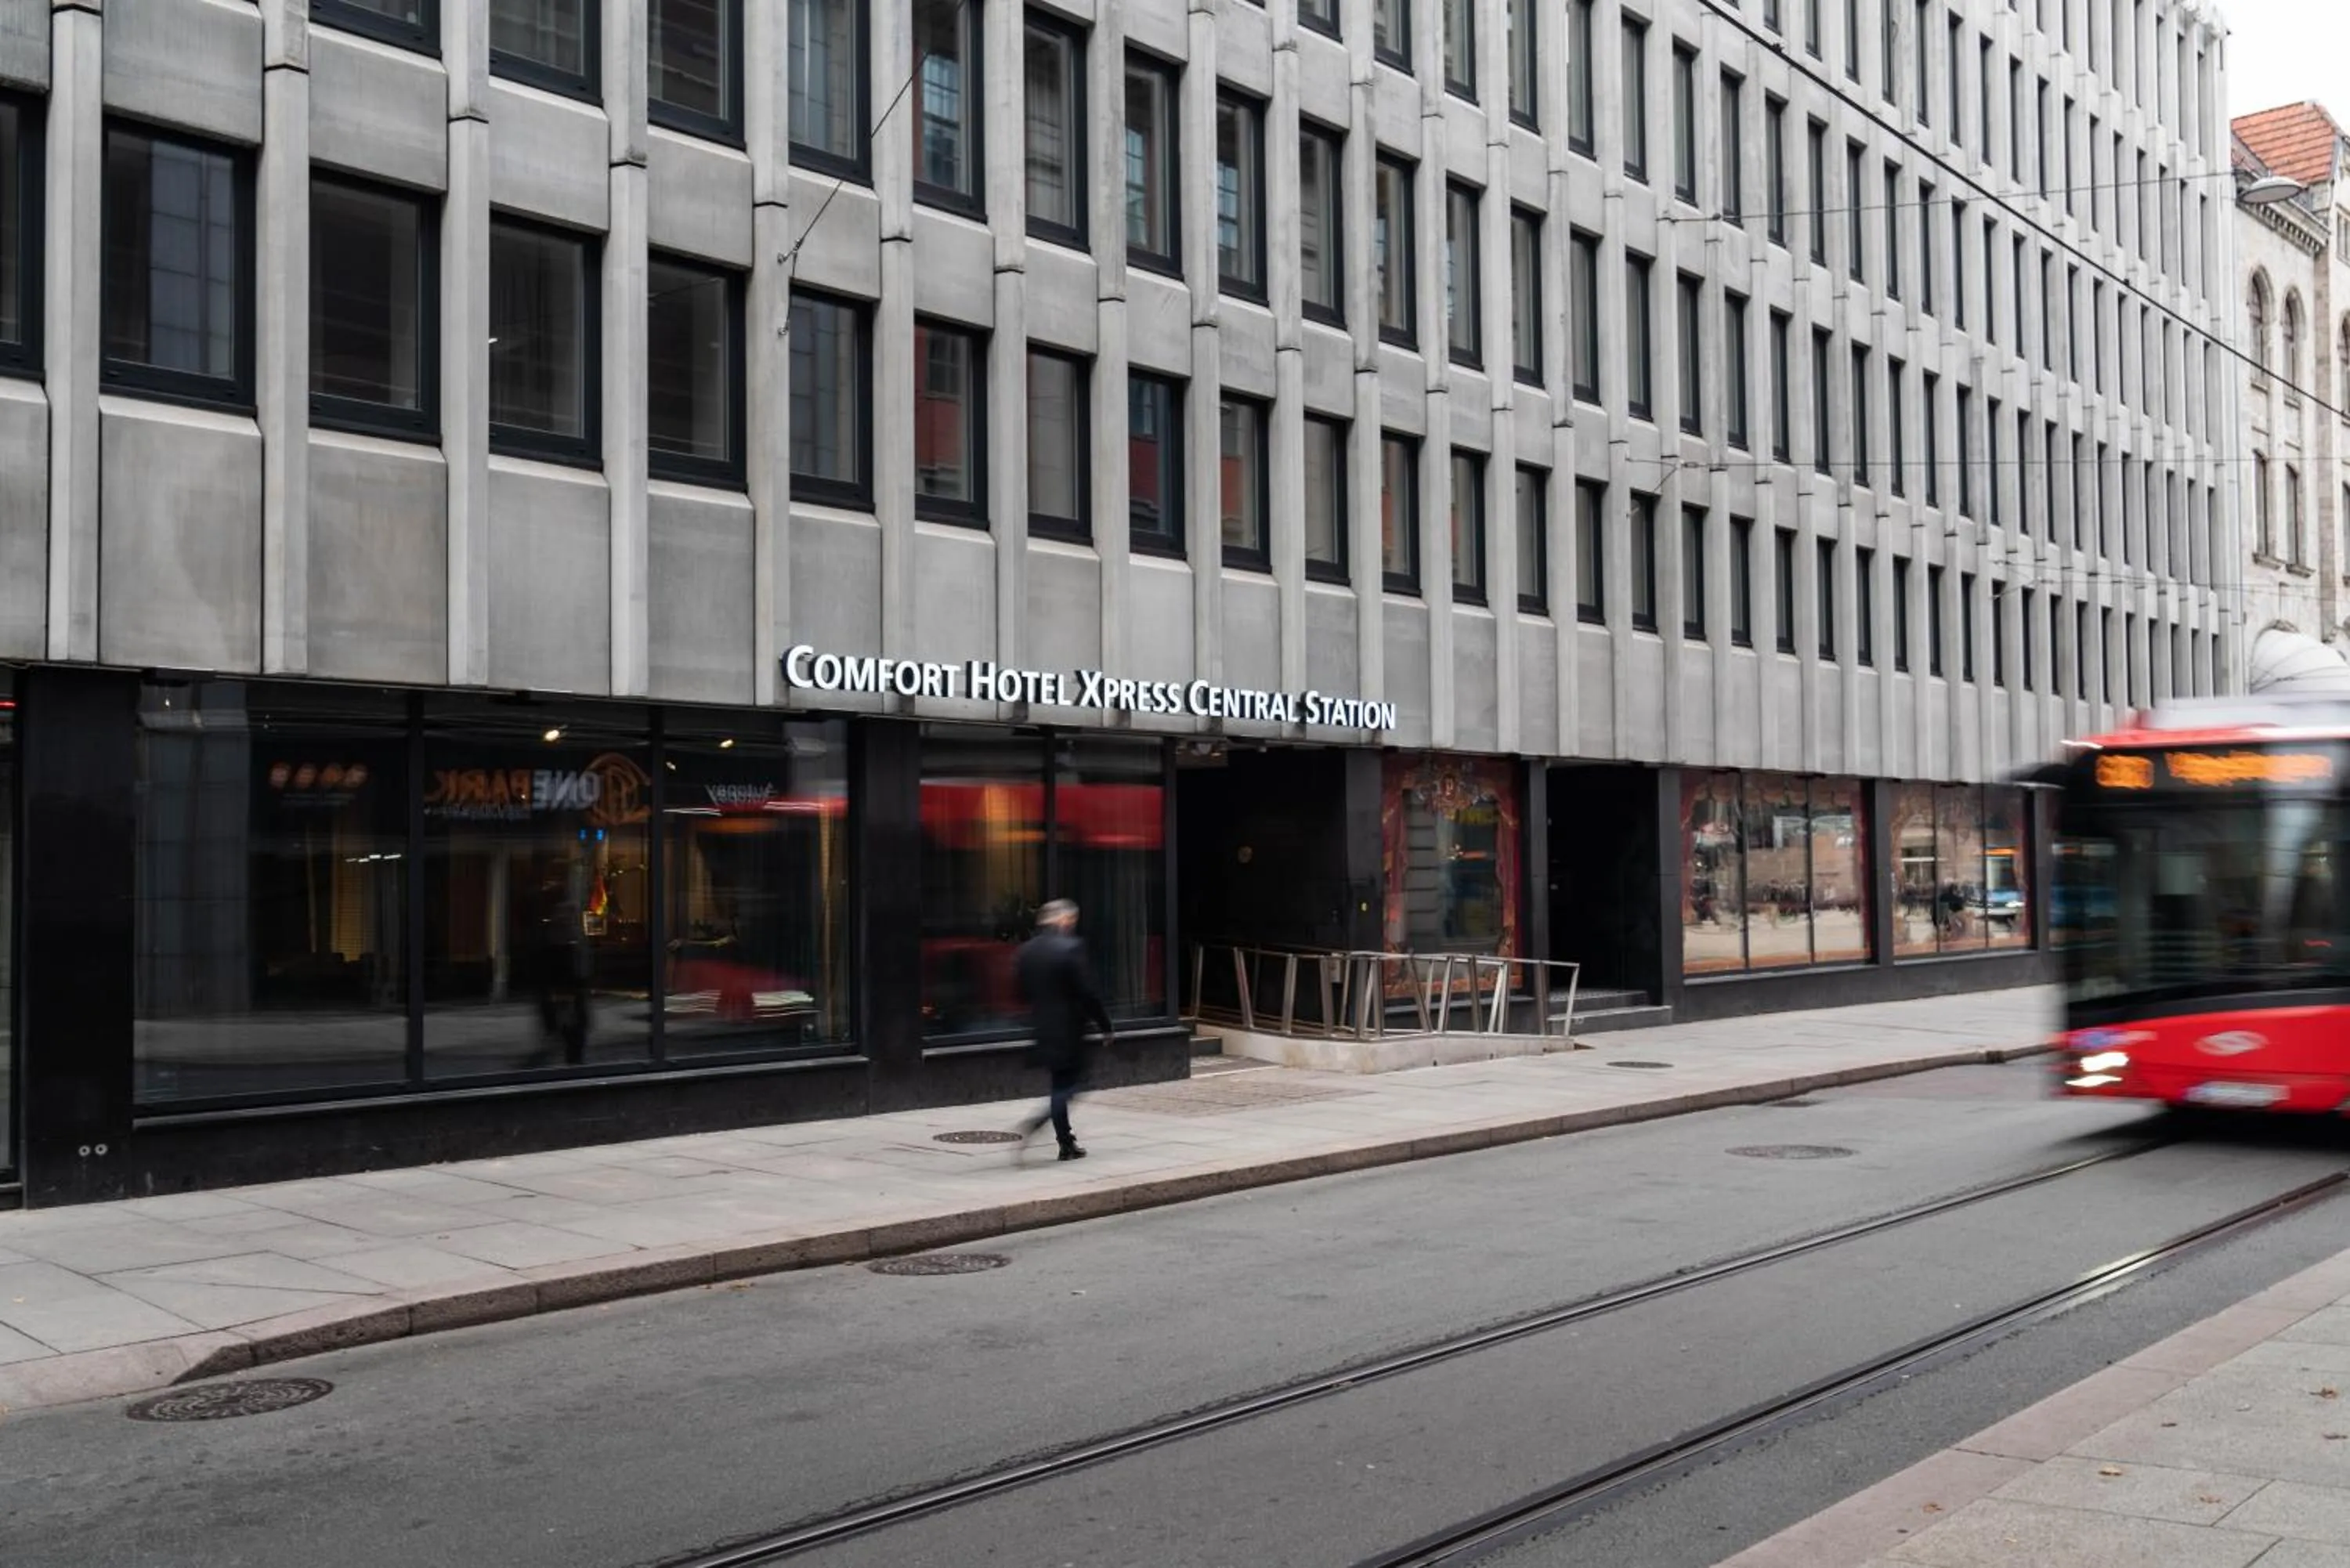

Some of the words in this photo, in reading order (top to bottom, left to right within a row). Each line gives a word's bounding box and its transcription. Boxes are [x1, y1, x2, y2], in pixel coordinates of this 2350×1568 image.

[785, 645, 961, 699] COMFORT
[970, 659, 1073, 706] HOTEL
[1078, 670, 1182, 714] XPRESS
[1187, 679, 1301, 723] CENTRAL
[1304, 690, 1397, 730] STATION
